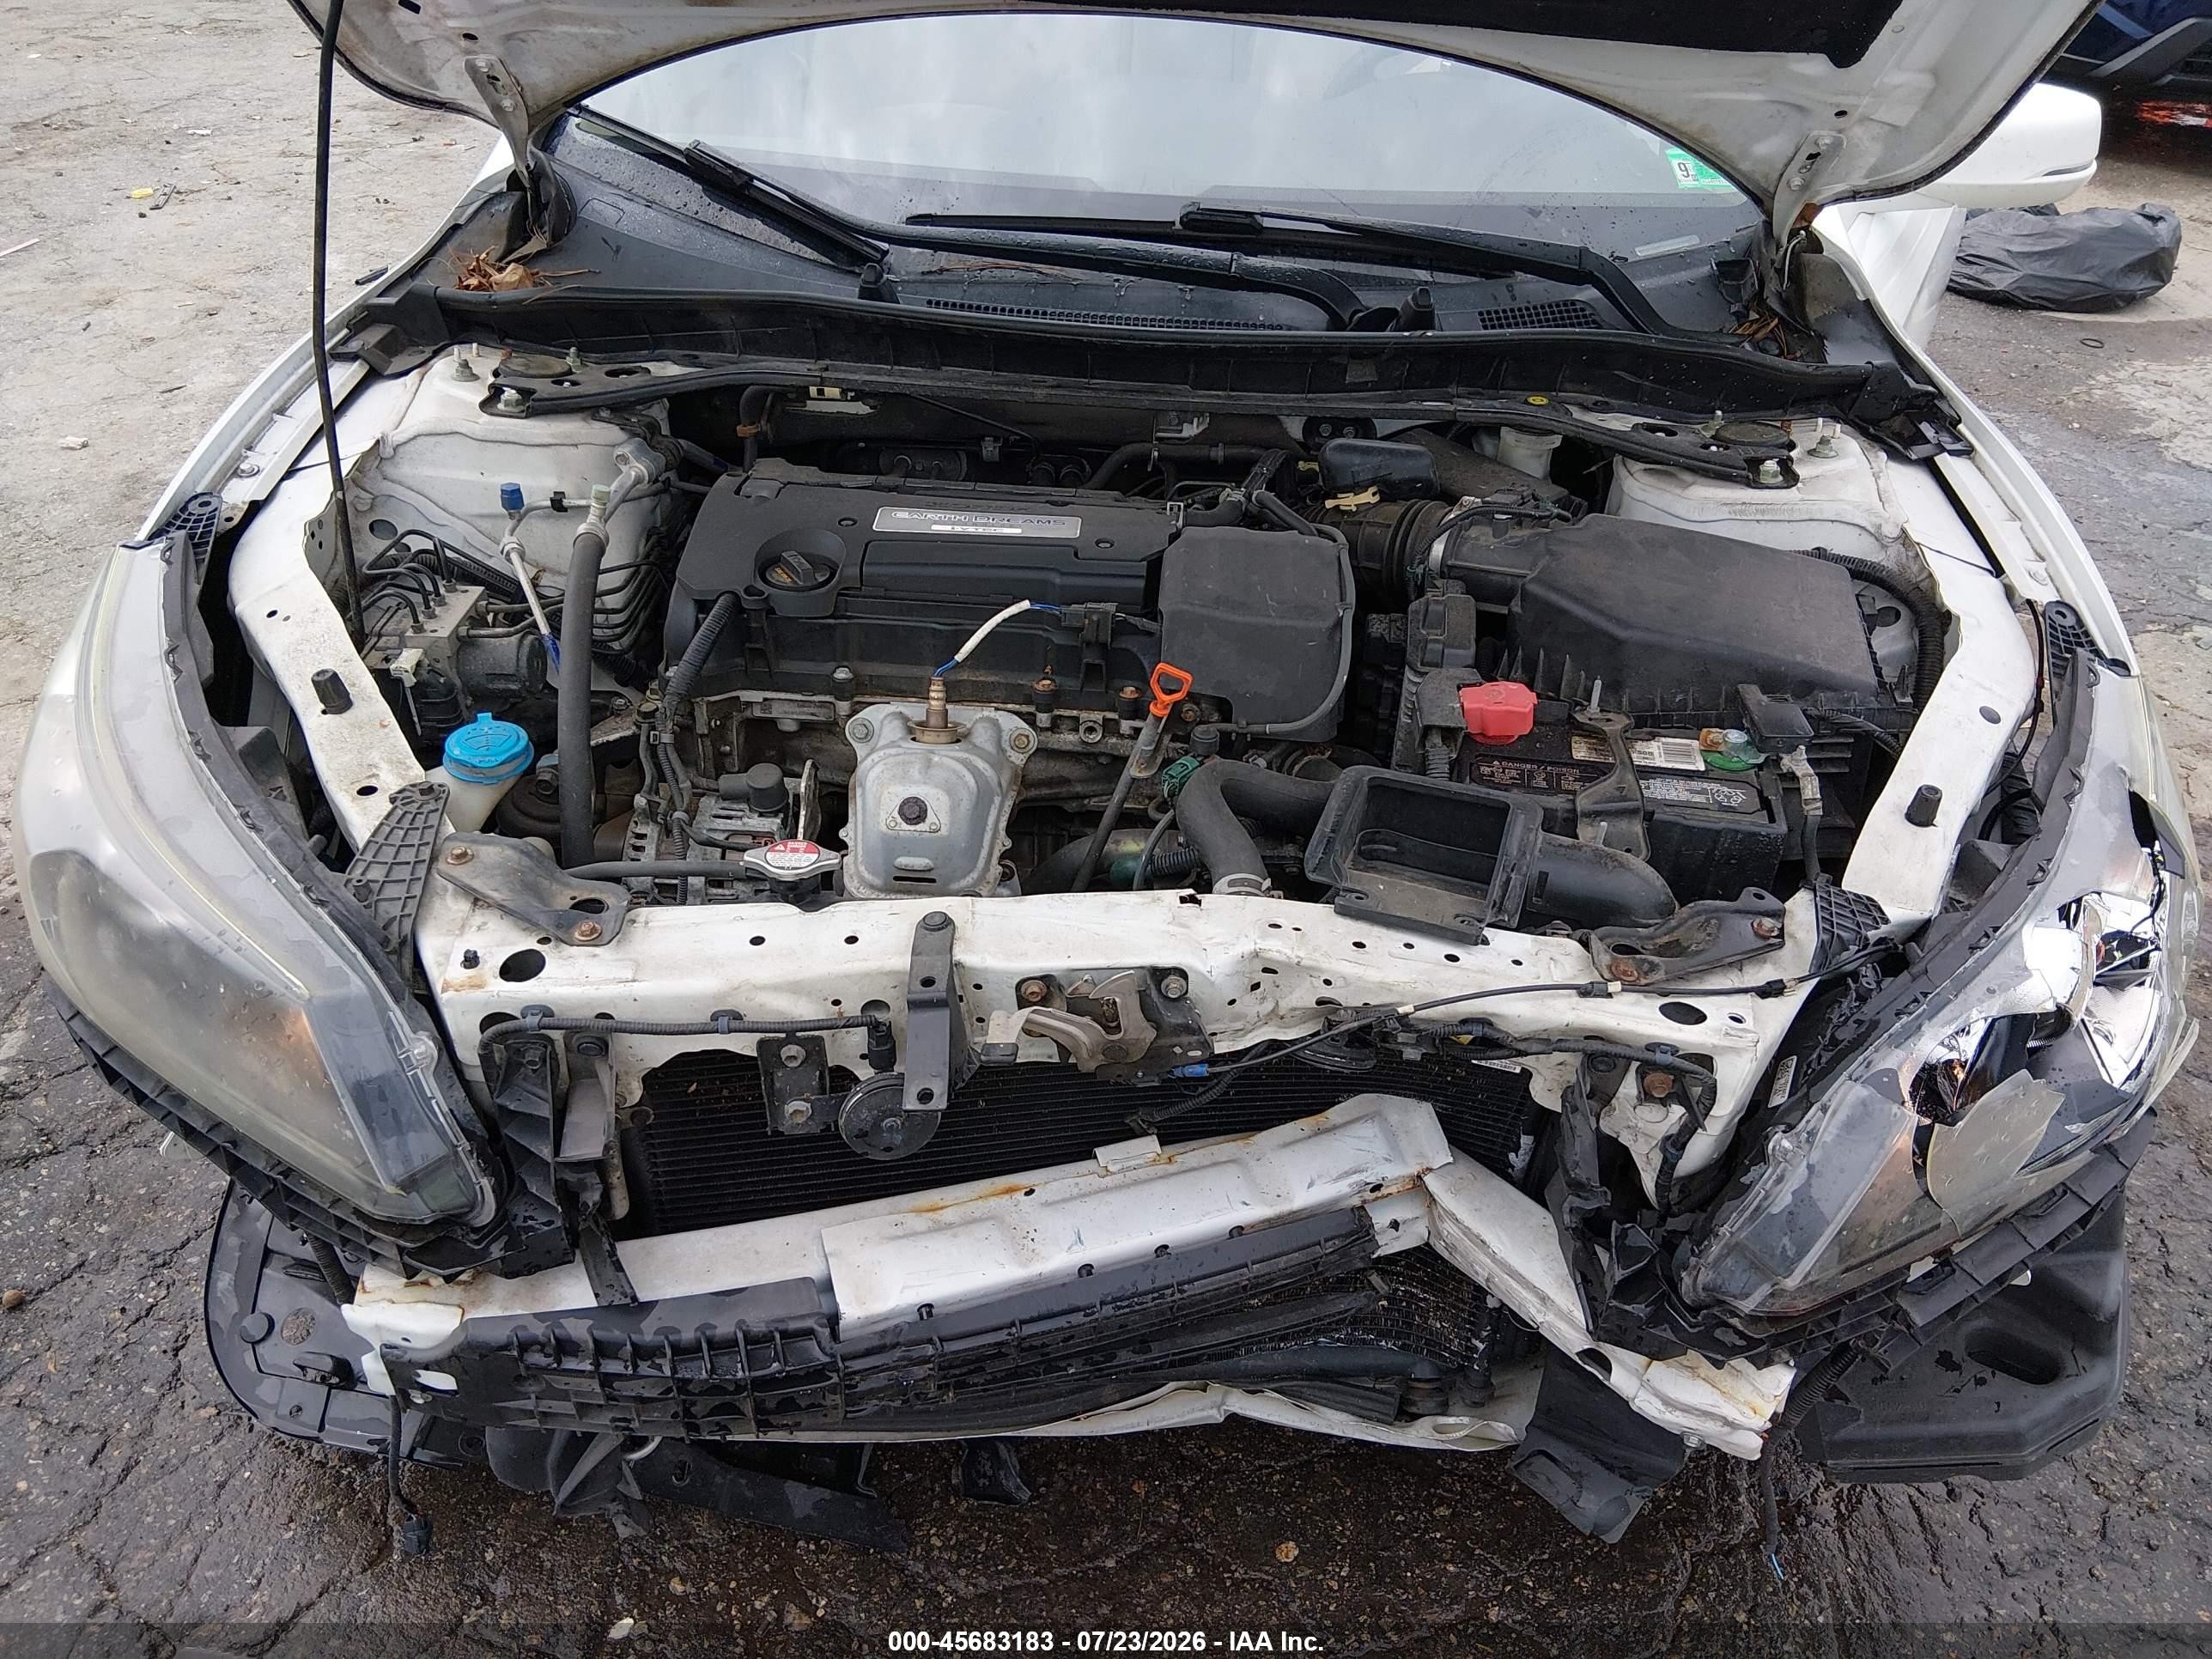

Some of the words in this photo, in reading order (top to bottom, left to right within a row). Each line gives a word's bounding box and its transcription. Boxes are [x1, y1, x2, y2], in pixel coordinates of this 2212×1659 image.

[1677, 161, 1690, 178] 9
[891, 510, 969, 523] EARTH
[972, 514, 1066, 526] DREAMS
[1501, 761, 1539, 770] DANGER
[1547, 765, 1580, 775] POISON
